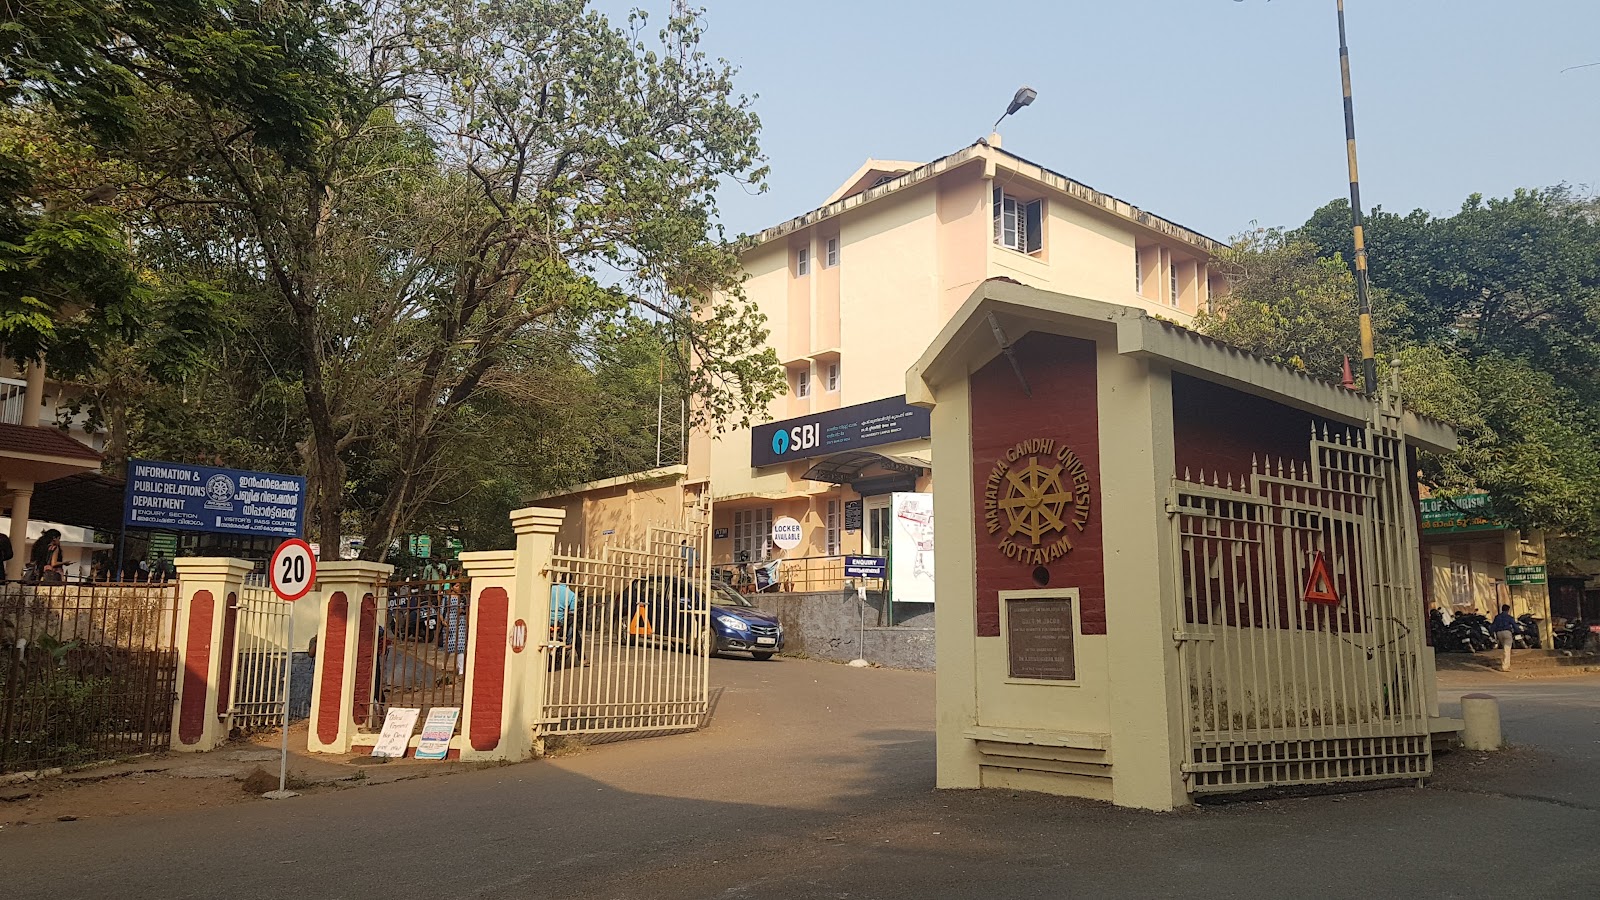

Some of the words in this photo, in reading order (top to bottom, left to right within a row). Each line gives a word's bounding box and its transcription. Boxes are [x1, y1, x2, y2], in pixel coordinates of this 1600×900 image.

[790, 422, 820, 451] SBI
[135, 465, 191, 481] INFORMATION
[193, 471, 200, 481] &
[134, 480, 163, 493] PUBLIC
[164, 482, 206, 497] RELATIONS
[984, 459, 1009, 535] MAHATMA
[1006, 438, 1055, 462] GANDHI
[1056, 444, 1091, 532] UNIVERSITY
[132, 495, 186, 510] DEPARTMENT
[138, 509, 166, 517] ENQUIRY
[774, 533, 800, 541] AVAILABLE
[997, 535, 1074, 565] KOTTAYAM
[281, 555, 305, 584] 20
[852, 558, 877, 566] ENQUIRY
[513, 625, 525, 647] IN
